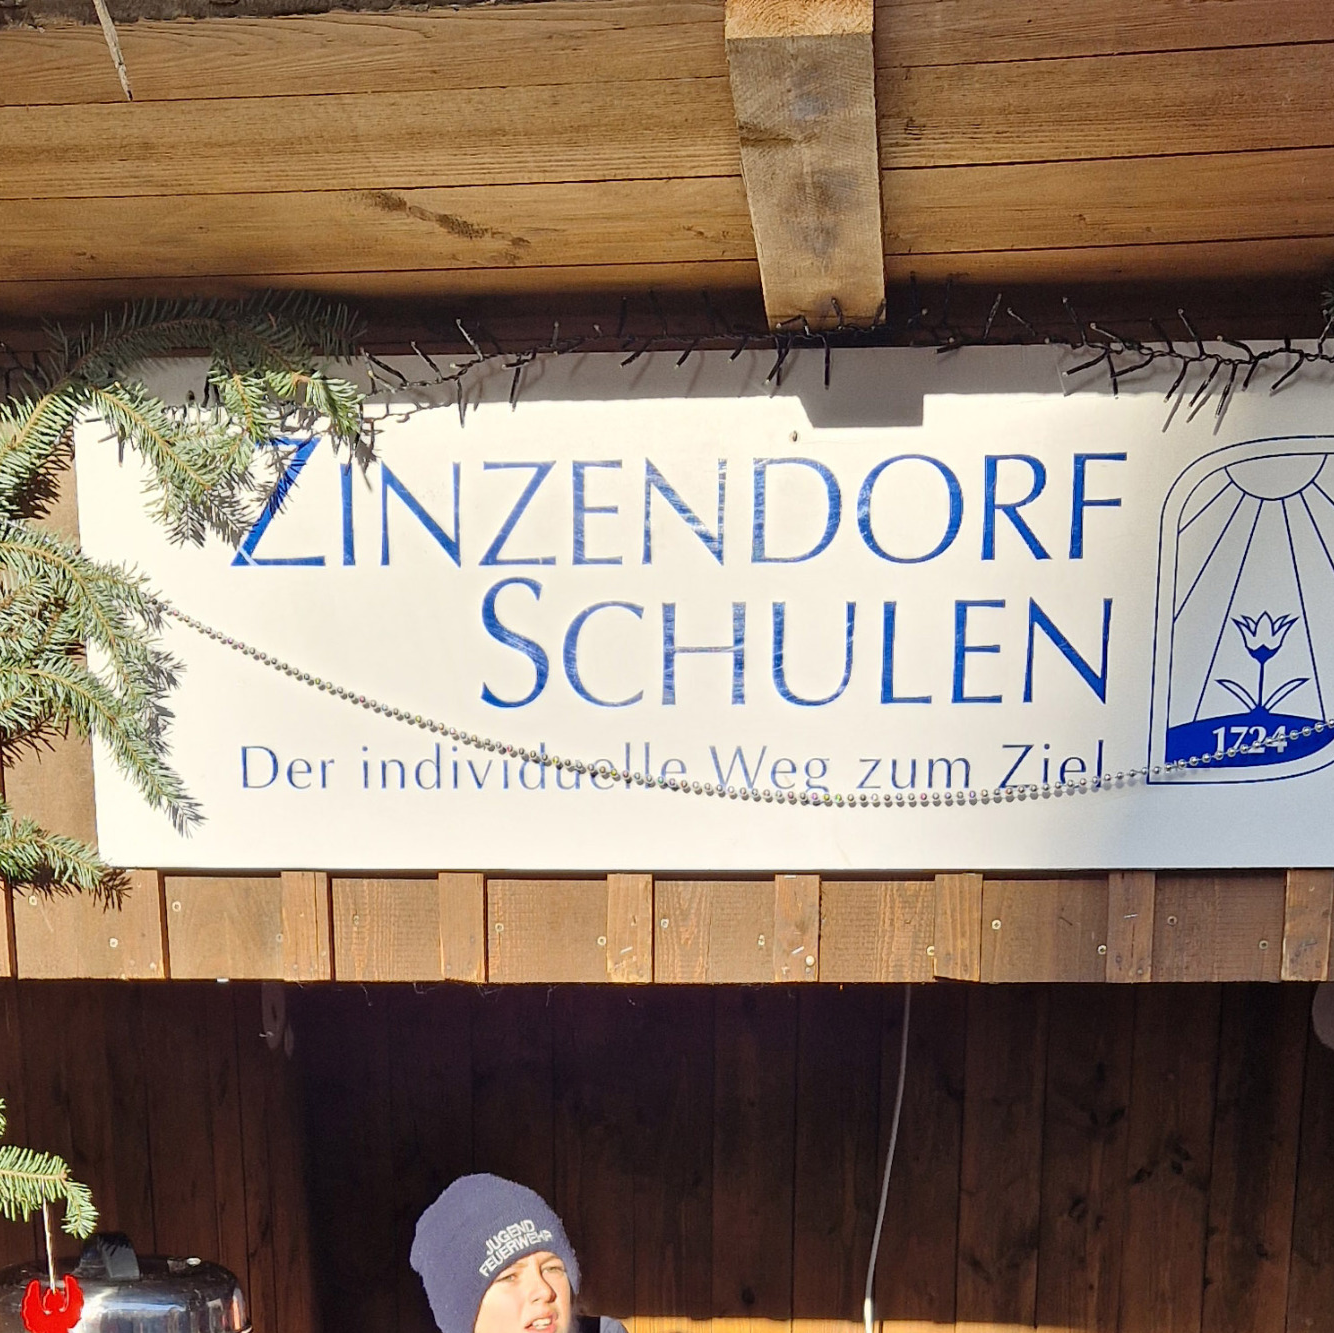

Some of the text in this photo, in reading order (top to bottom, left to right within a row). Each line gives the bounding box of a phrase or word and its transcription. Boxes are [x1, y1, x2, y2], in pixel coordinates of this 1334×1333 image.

[230, 437, 1124, 567] ZINZENDORF
[480, 576, 1113, 708] SCHULEN
[1212, 725, 1287, 755] 1724
[241, 739, 1104, 803] Der individuelle Weg zum Ziel
[478, 1228, 553, 1277] FEUERWEHR
[485, 1219, 536, 1256] JUGEND
